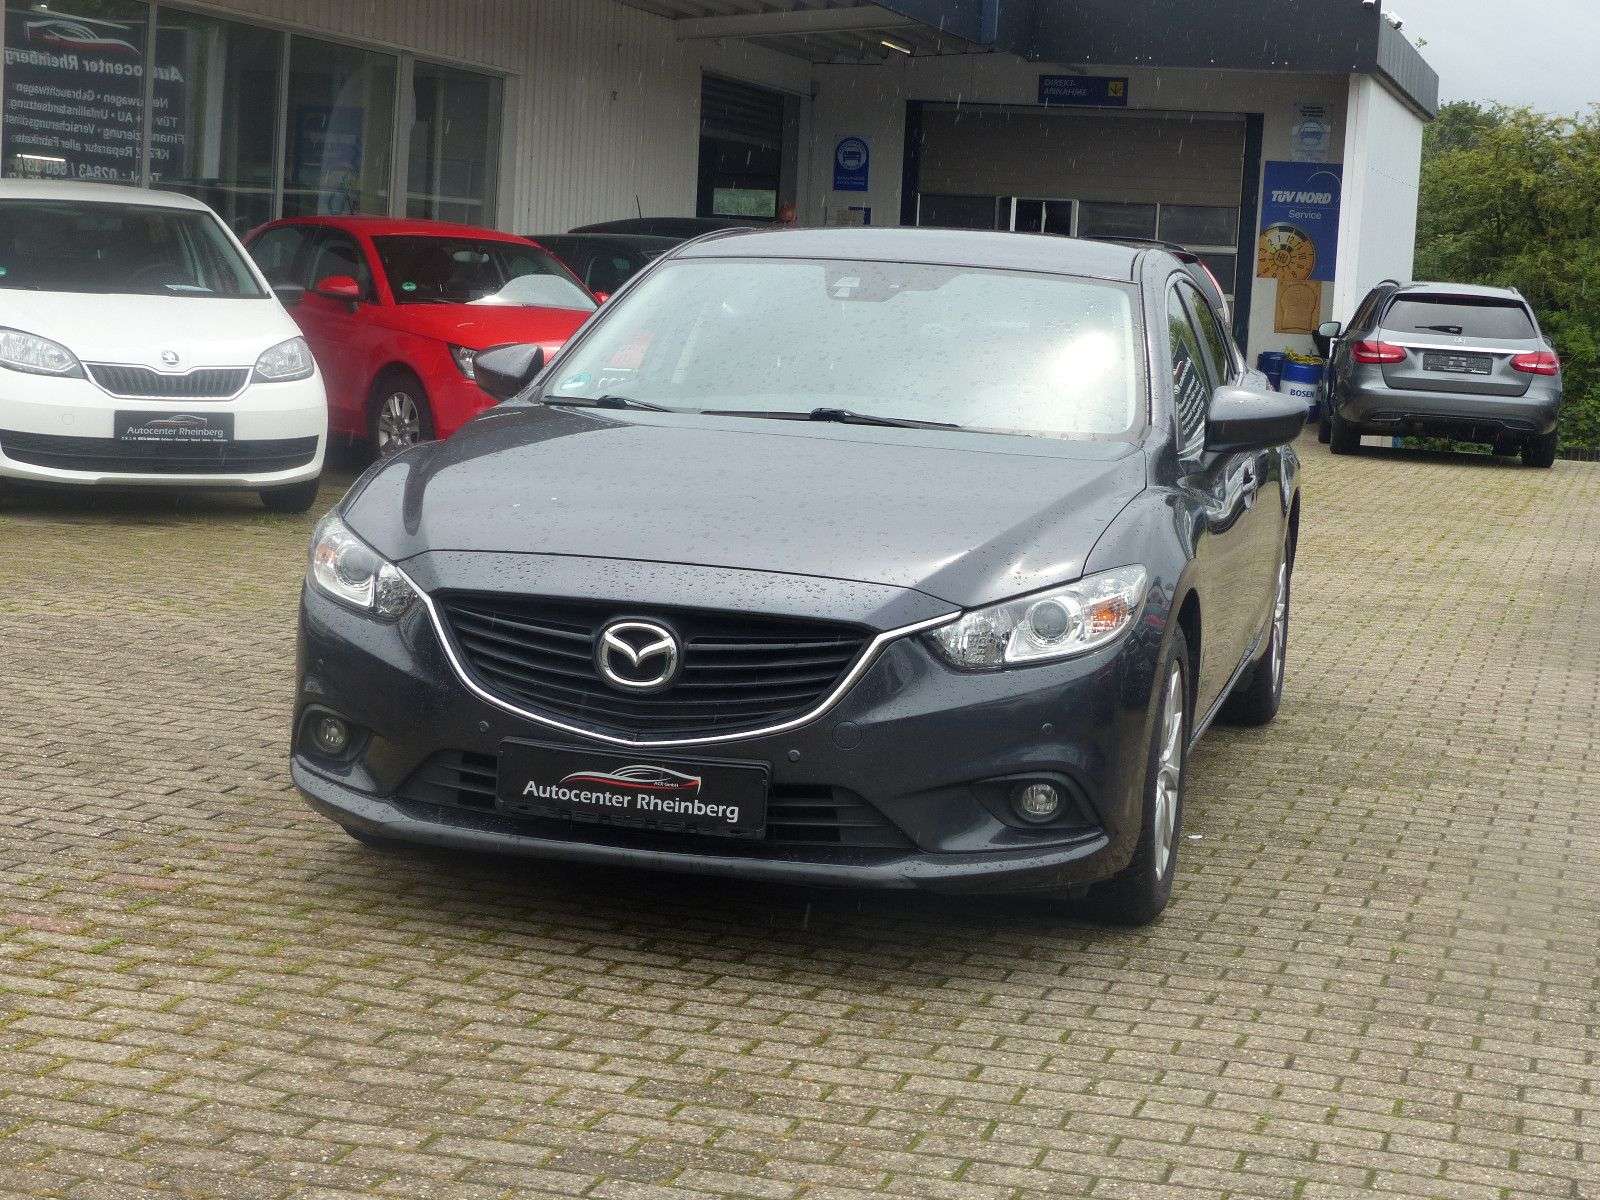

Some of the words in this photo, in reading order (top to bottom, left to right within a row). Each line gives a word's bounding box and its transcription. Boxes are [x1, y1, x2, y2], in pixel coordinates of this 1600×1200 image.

[1272, 189, 1296, 202] TÜV
[1296, 191, 1332, 204] NORD
[1289, 209, 1322, 220] Service
[127, 427, 176, 436] Autocenter
[179, 428, 224, 438] Rheinberg
[523, 780, 632, 809] Autocenter
[637, 793, 739, 824] Rheinberg
